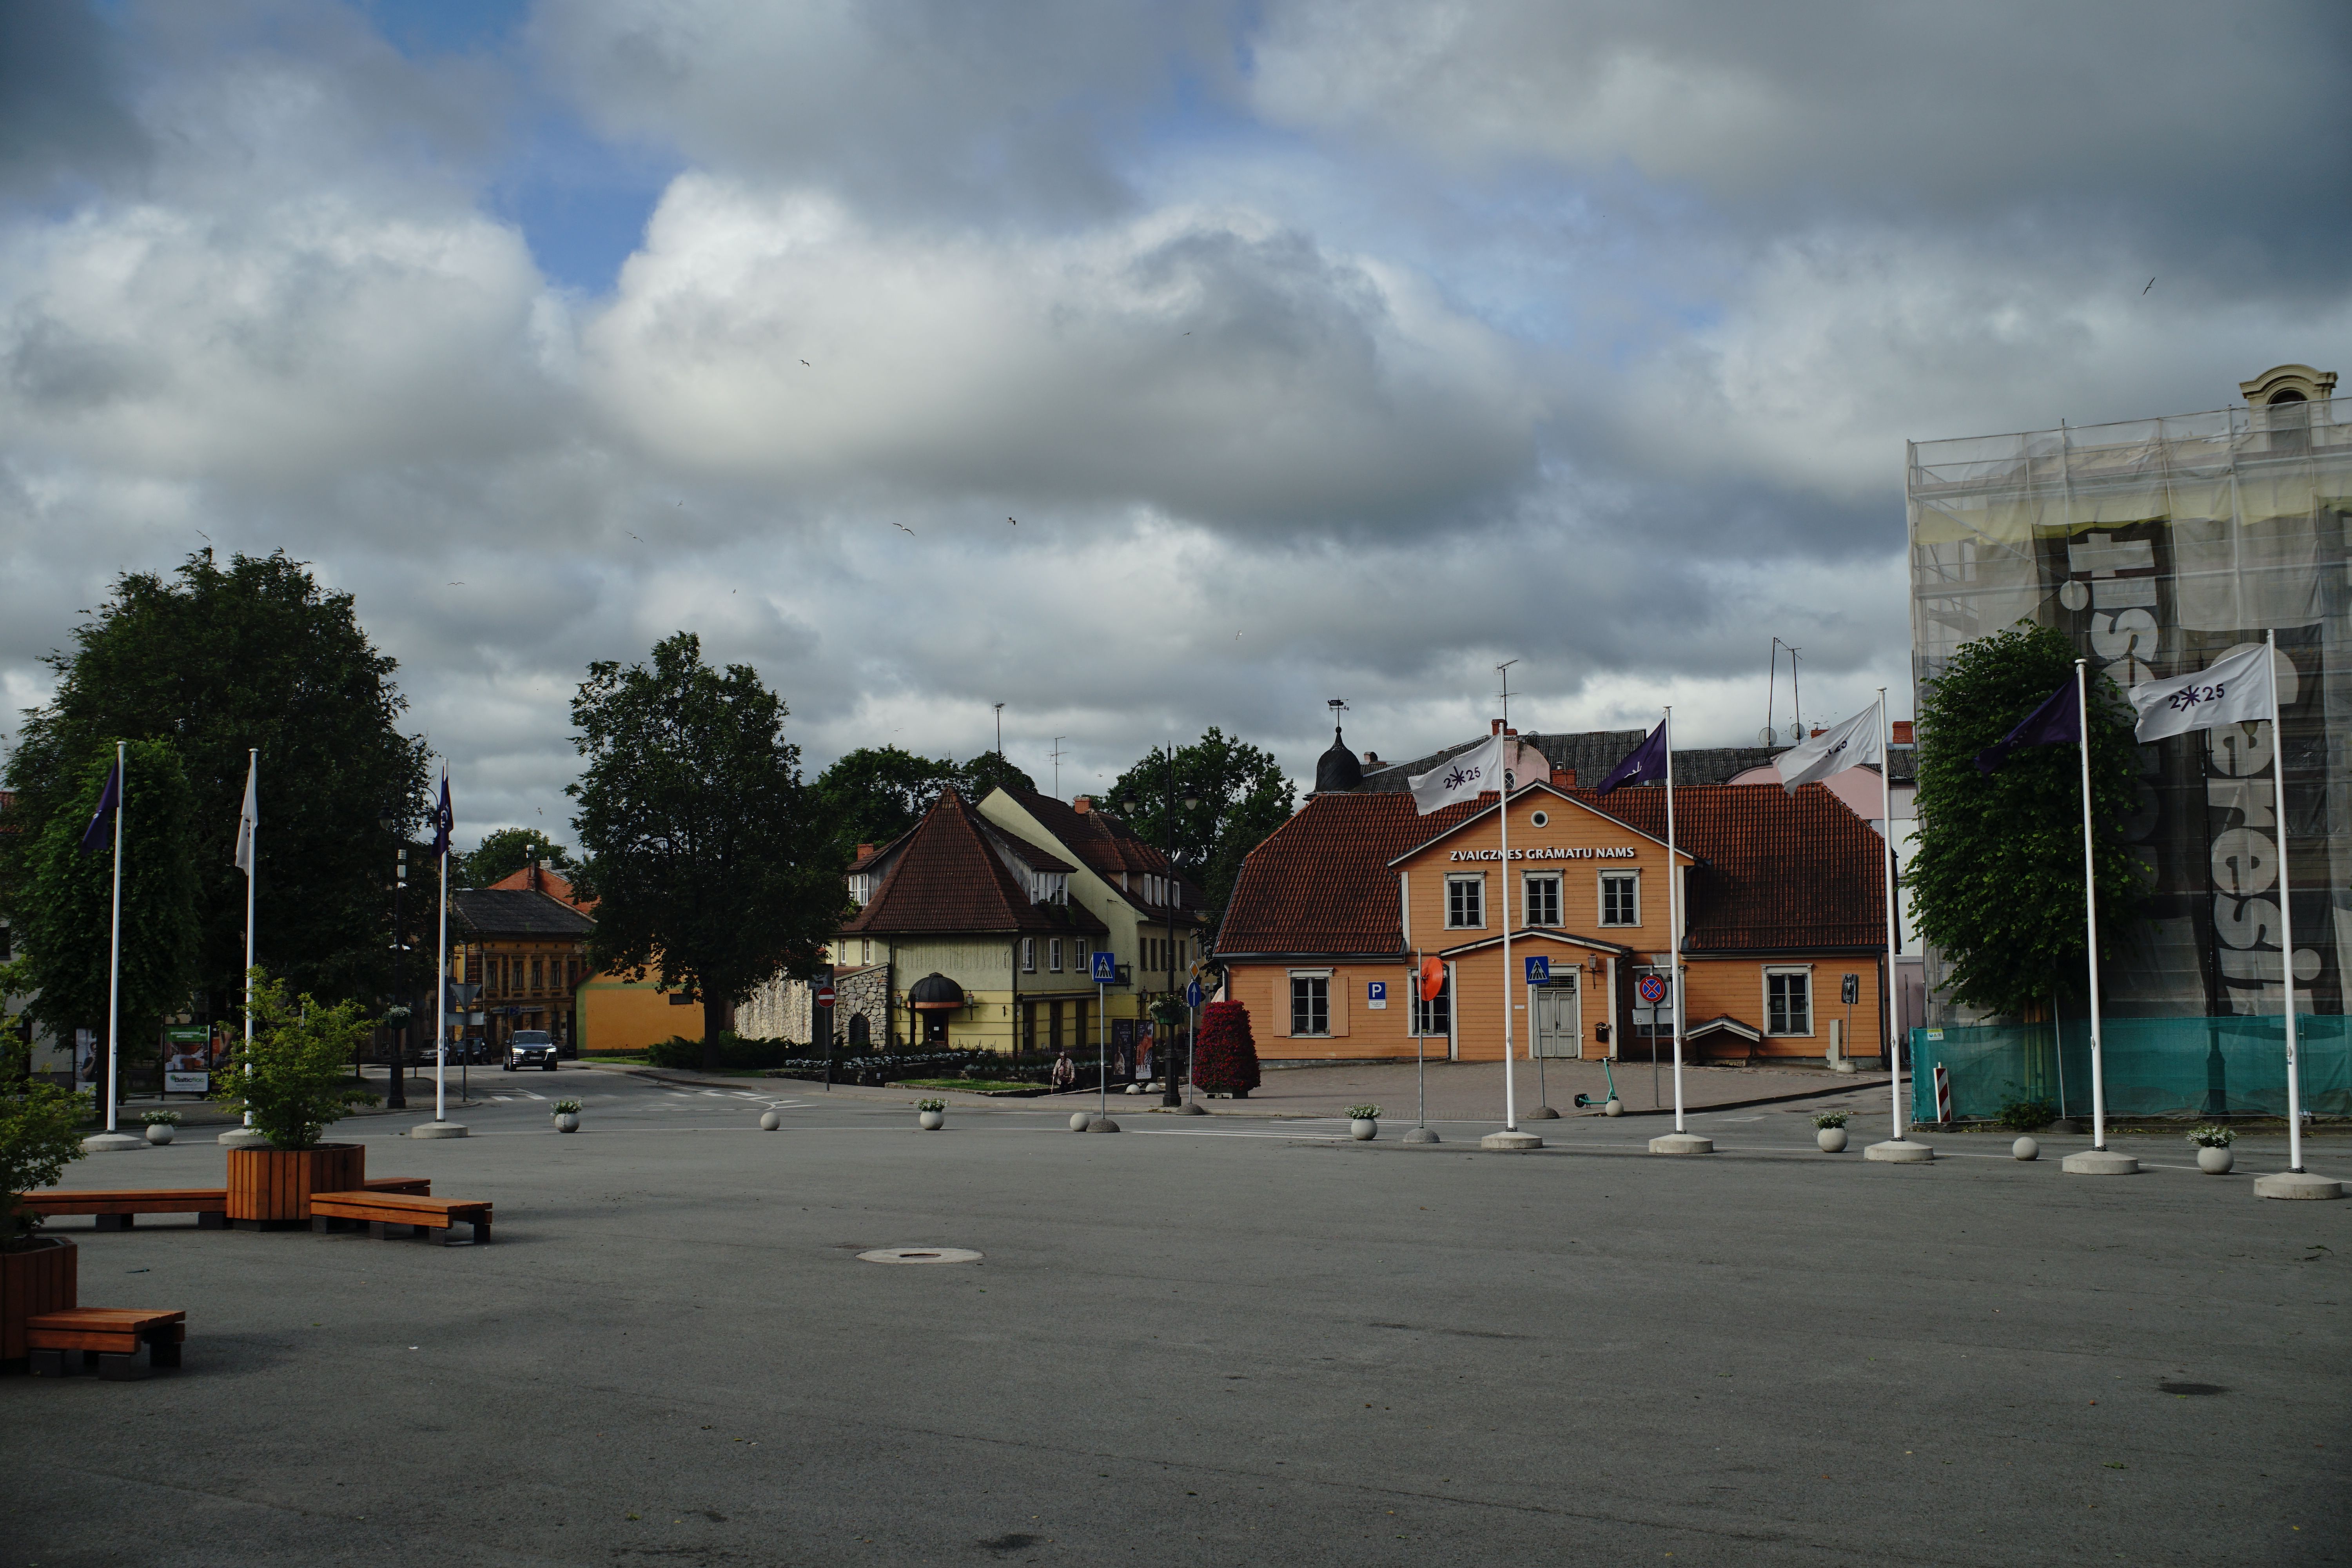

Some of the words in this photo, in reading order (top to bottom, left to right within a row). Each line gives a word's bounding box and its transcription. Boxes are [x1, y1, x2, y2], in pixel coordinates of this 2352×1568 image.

[1450, 849, 1523, 861] ZVAIGZNES
[1526, 846, 1592, 859] GRĀMATU
[1596, 847, 1635, 858] NAMS
[1372, 984, 1382, 998] P
